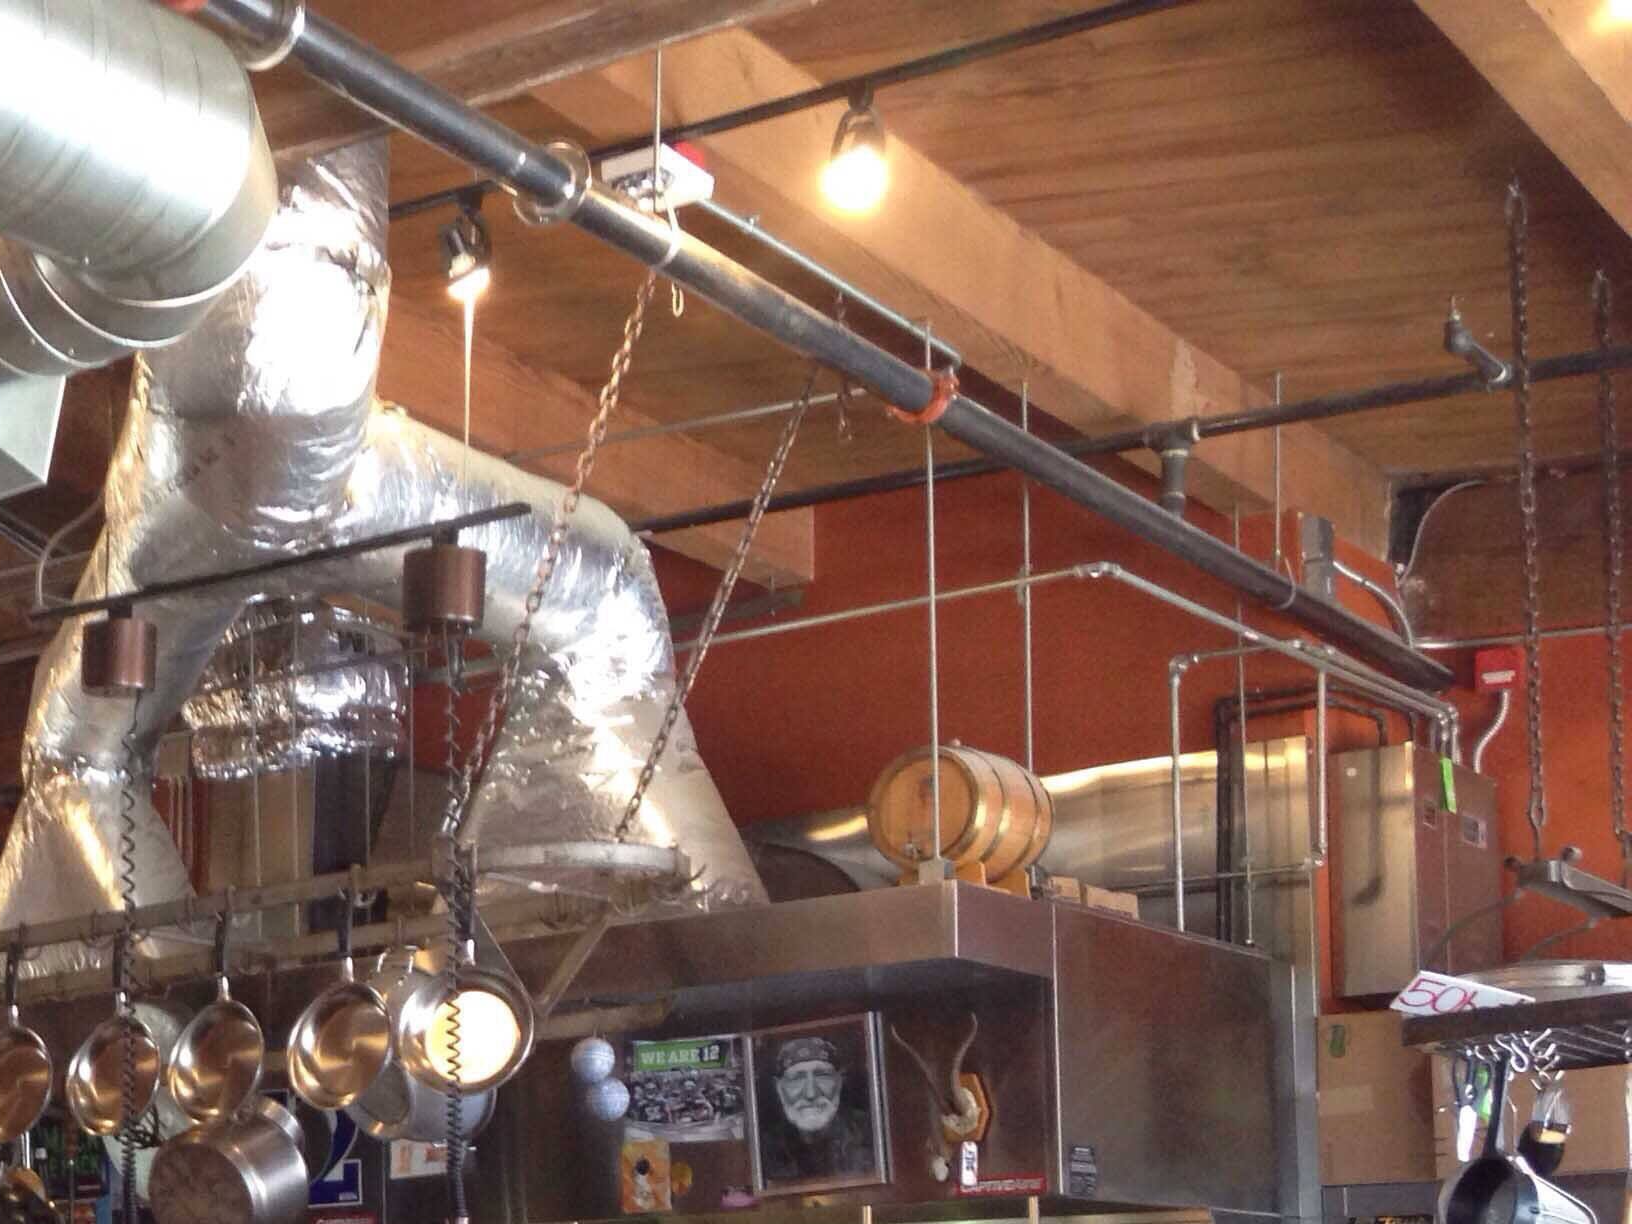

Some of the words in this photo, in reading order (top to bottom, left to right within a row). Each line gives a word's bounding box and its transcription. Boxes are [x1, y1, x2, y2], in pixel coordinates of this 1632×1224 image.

[641, 1051, 666, 1065] WE
[669, 1048, 700, 1064] ARE
[702, 1044, 721, 1061] 12
